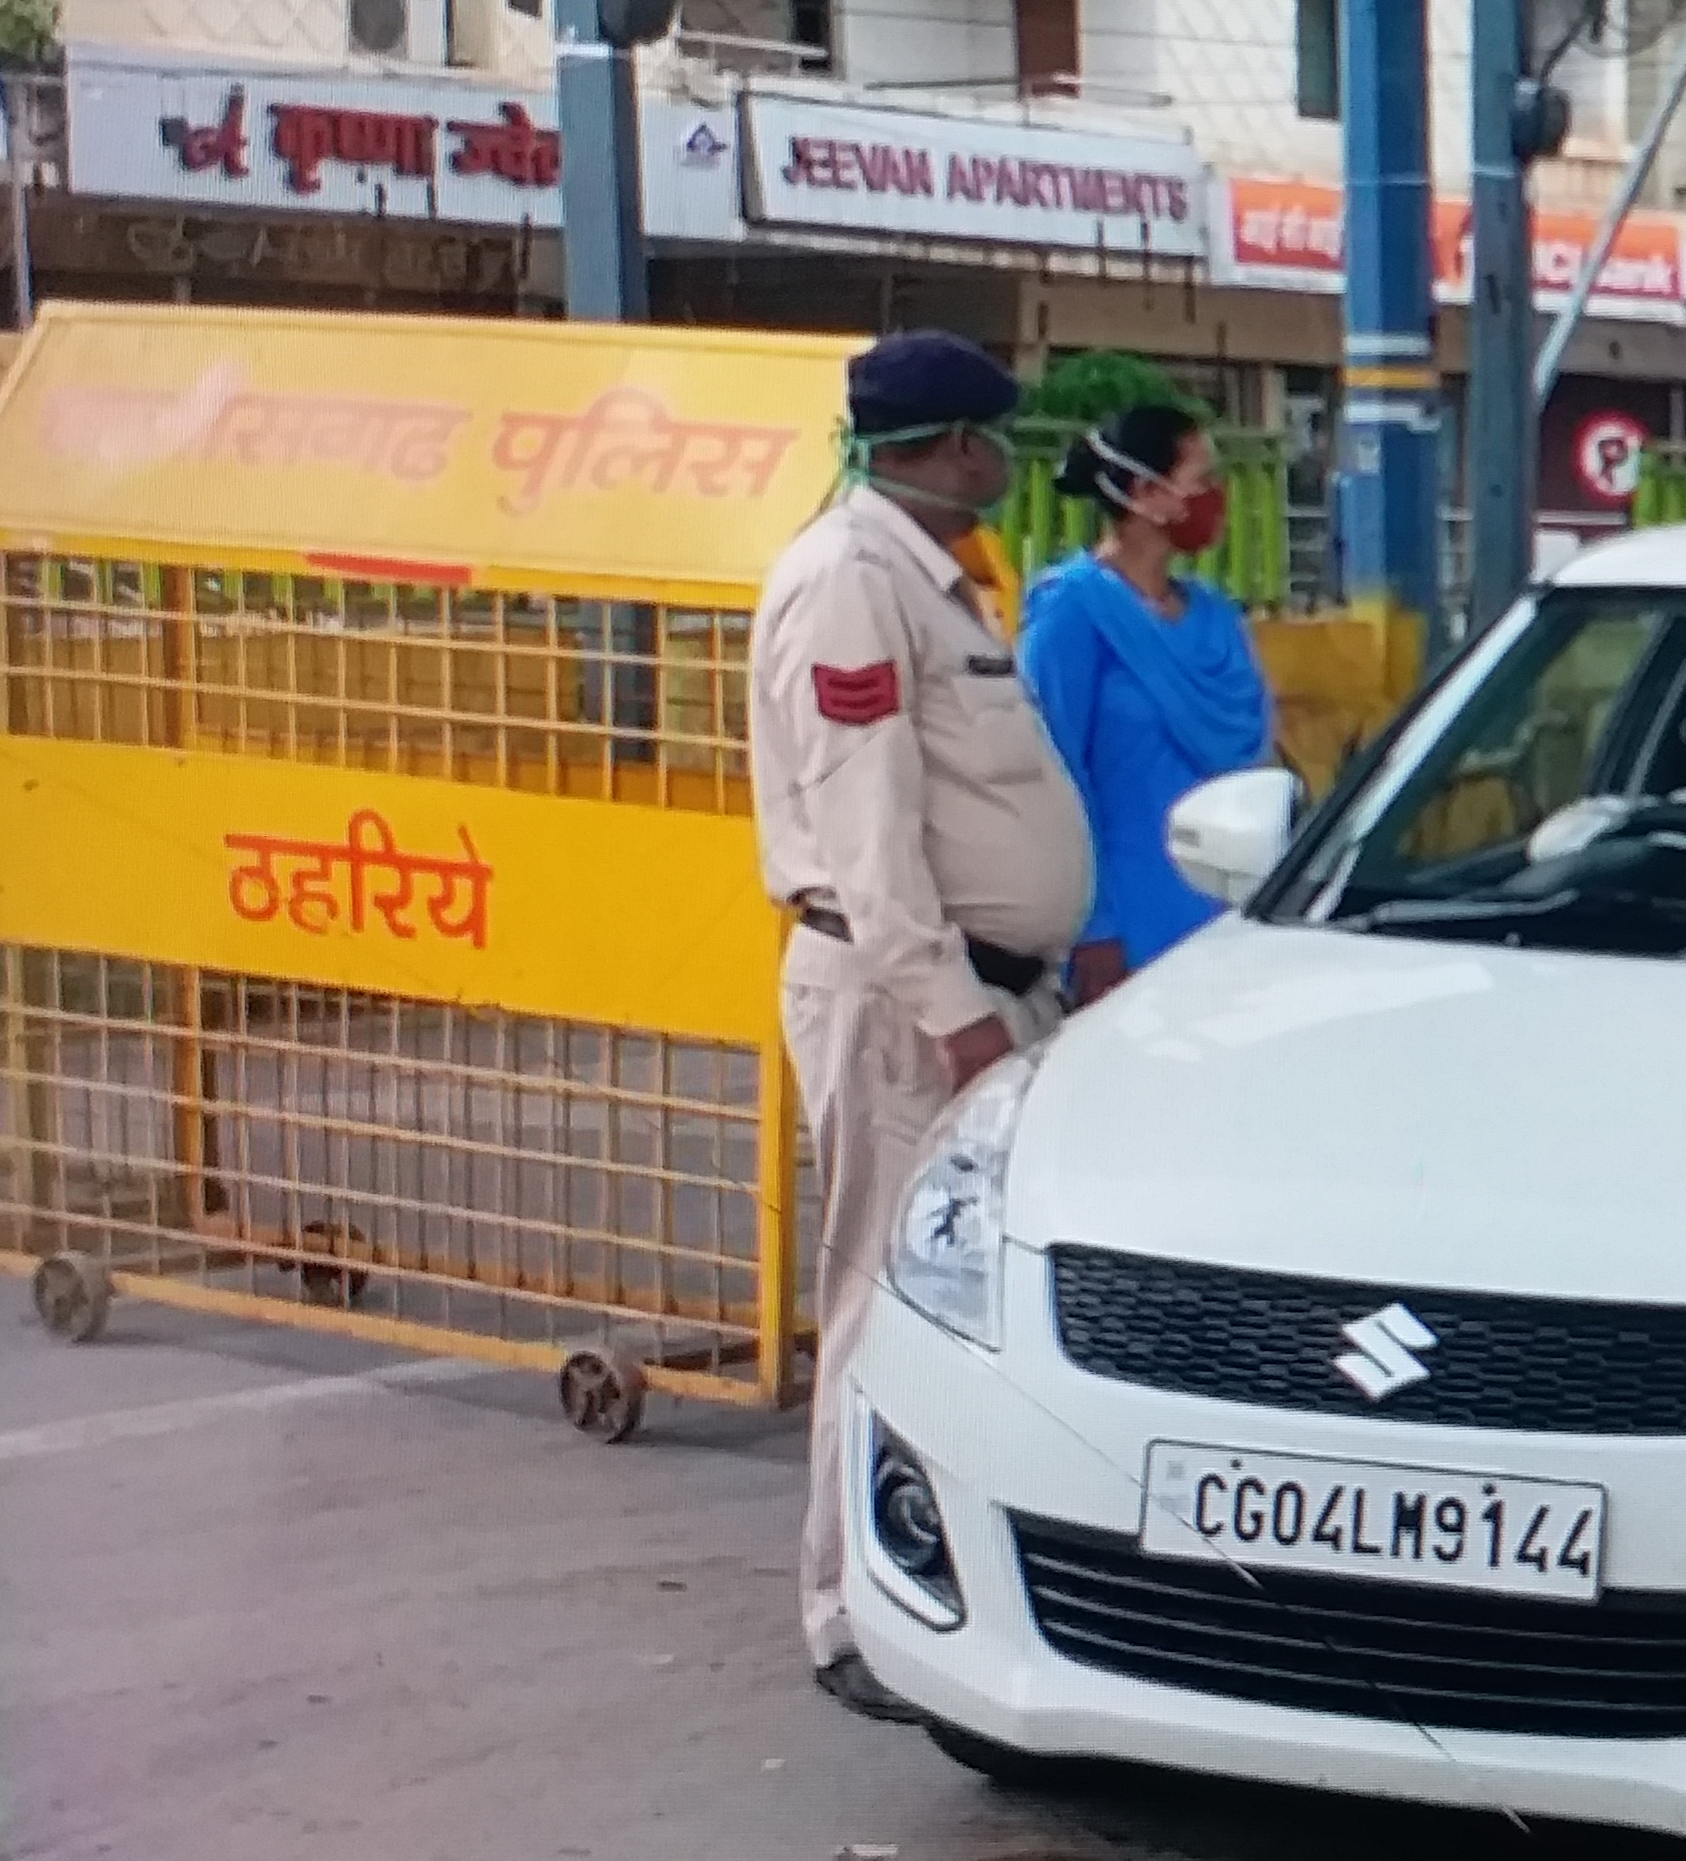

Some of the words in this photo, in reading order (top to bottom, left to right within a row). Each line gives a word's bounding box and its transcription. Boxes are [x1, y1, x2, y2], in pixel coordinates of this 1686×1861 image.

[782, 135, 934, 197] JEEVAN
[947, 152, 1189, 222] APARTMENTS
[492, 385, 800, 518] पुलिस
[224, 807, 494, 950] ठहरिये
[1195, 1471, 1594, 1577] CG04LM9144
